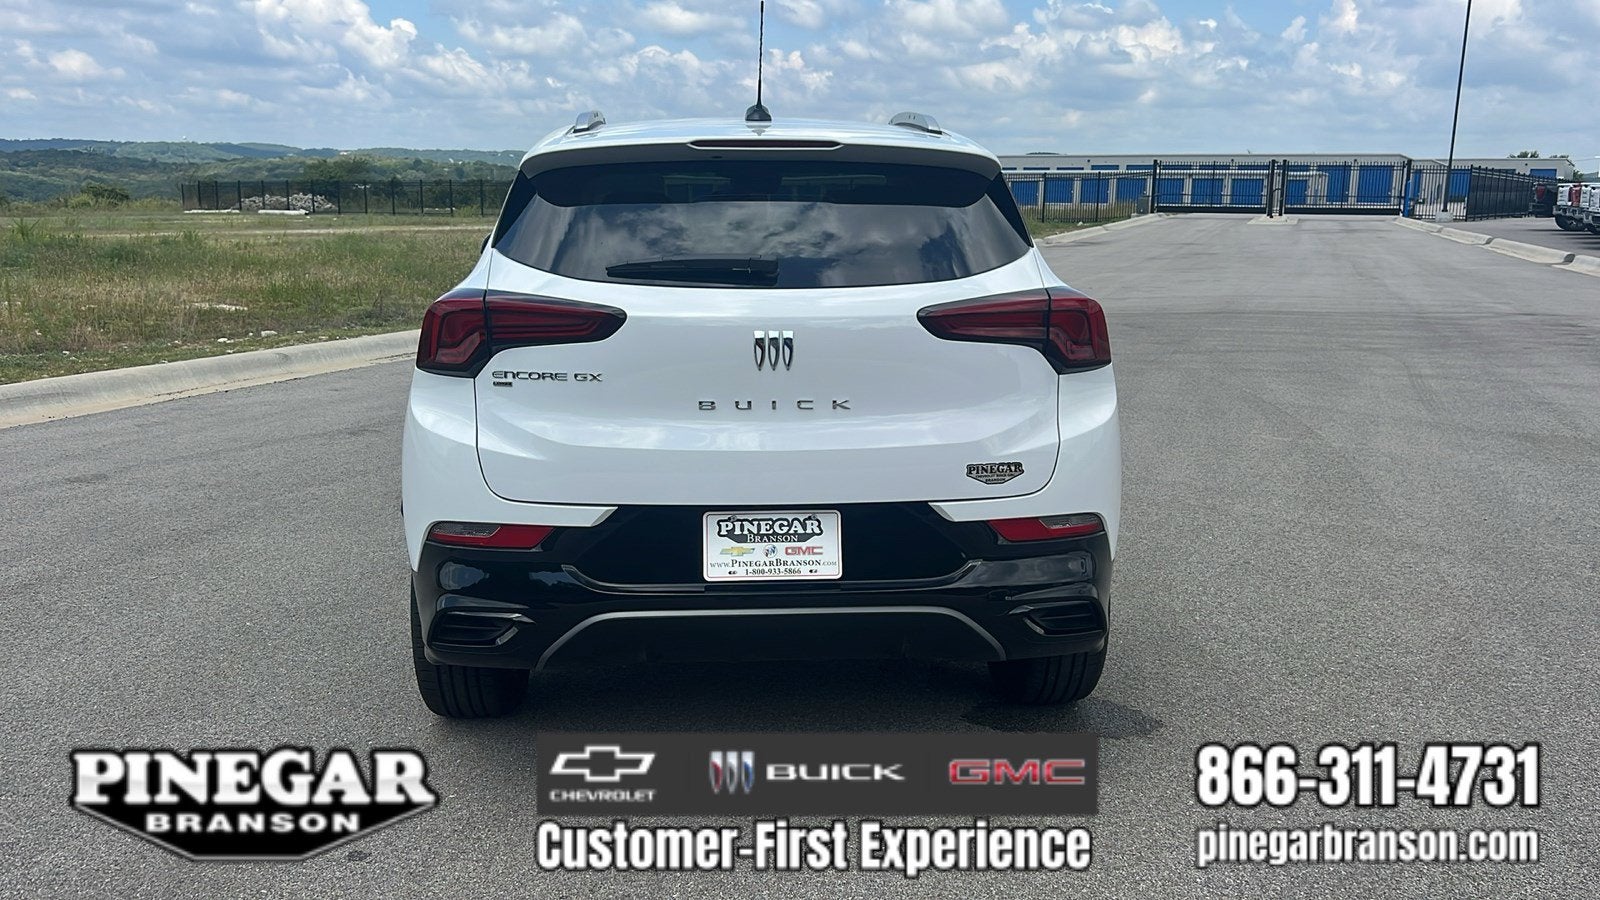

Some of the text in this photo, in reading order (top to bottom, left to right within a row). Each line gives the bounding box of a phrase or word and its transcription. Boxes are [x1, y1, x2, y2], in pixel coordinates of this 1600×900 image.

[492, 370, 603, 383] ENCORE GX
[698, 400, 851, 411] BUICK
[968, 464, 1022, 475] PINEGAR
[720, 520, 821, 534] PINEGAR
[748, 534, 798, 543] BRANSON
[784, 546, 824, 556] GMC
